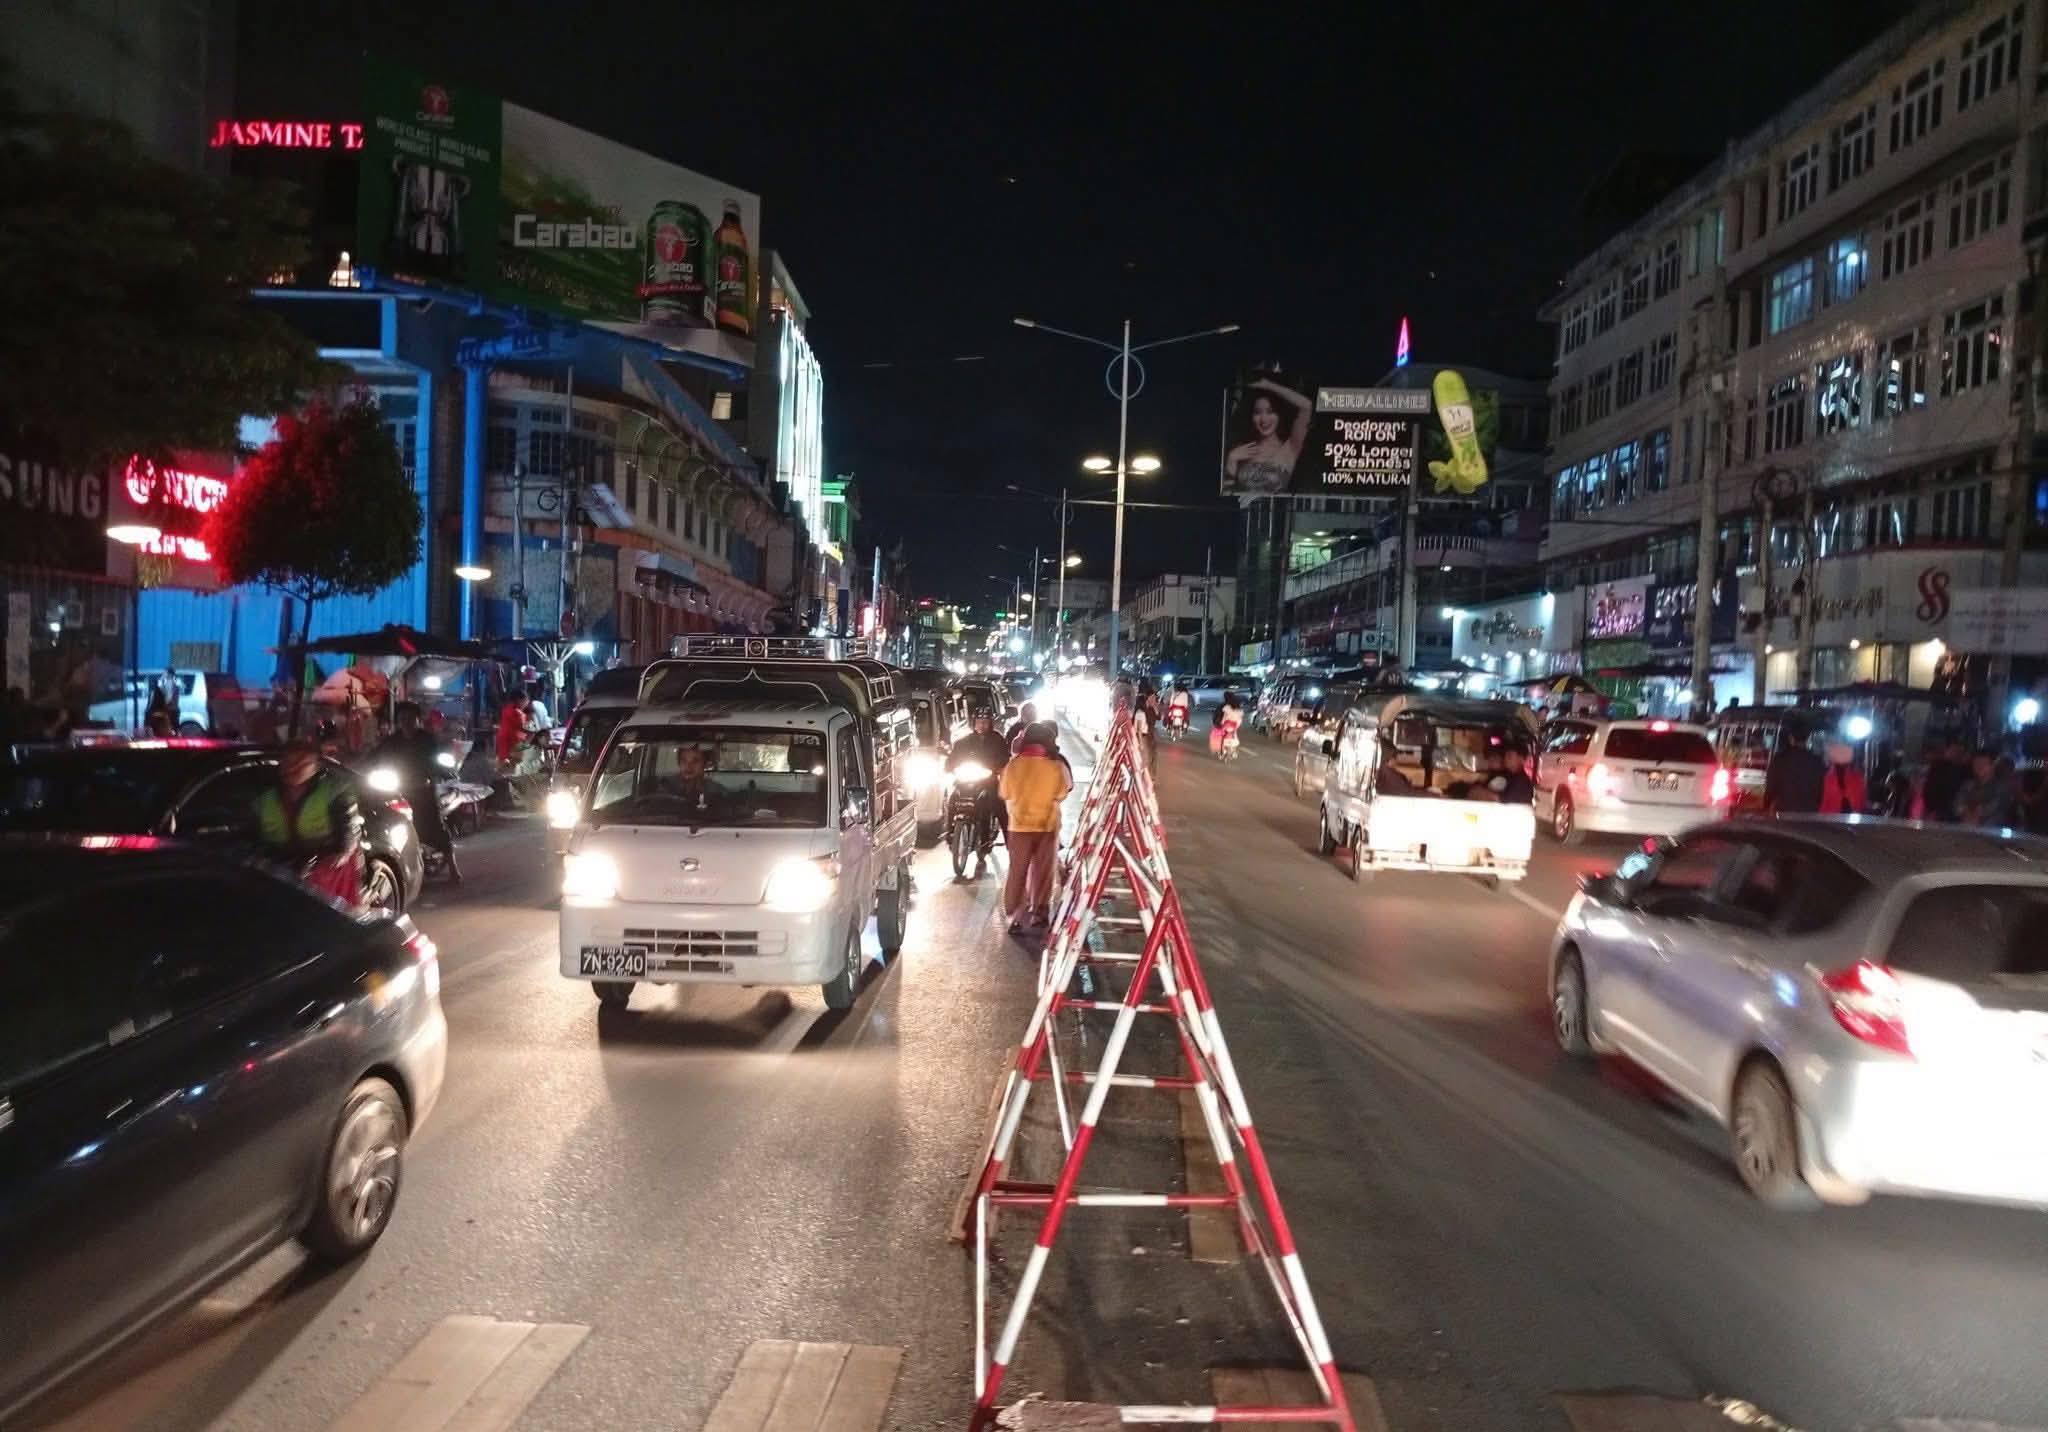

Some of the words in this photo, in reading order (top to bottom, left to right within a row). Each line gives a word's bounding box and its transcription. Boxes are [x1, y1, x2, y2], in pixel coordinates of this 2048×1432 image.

[210, 120, 332, 148] JASMINE
[341, 124, 364, 149] T
[513, 214, 637, 249] Carabao
[1333, 418, 1406, 432] Deodorant
[1375, 429, 1397, 442] ON
[1324, 443, 1357, 457] 50%
[1333, 454, 1411, 469] Freshness
[1322, 472, 1353, 485] 100%
